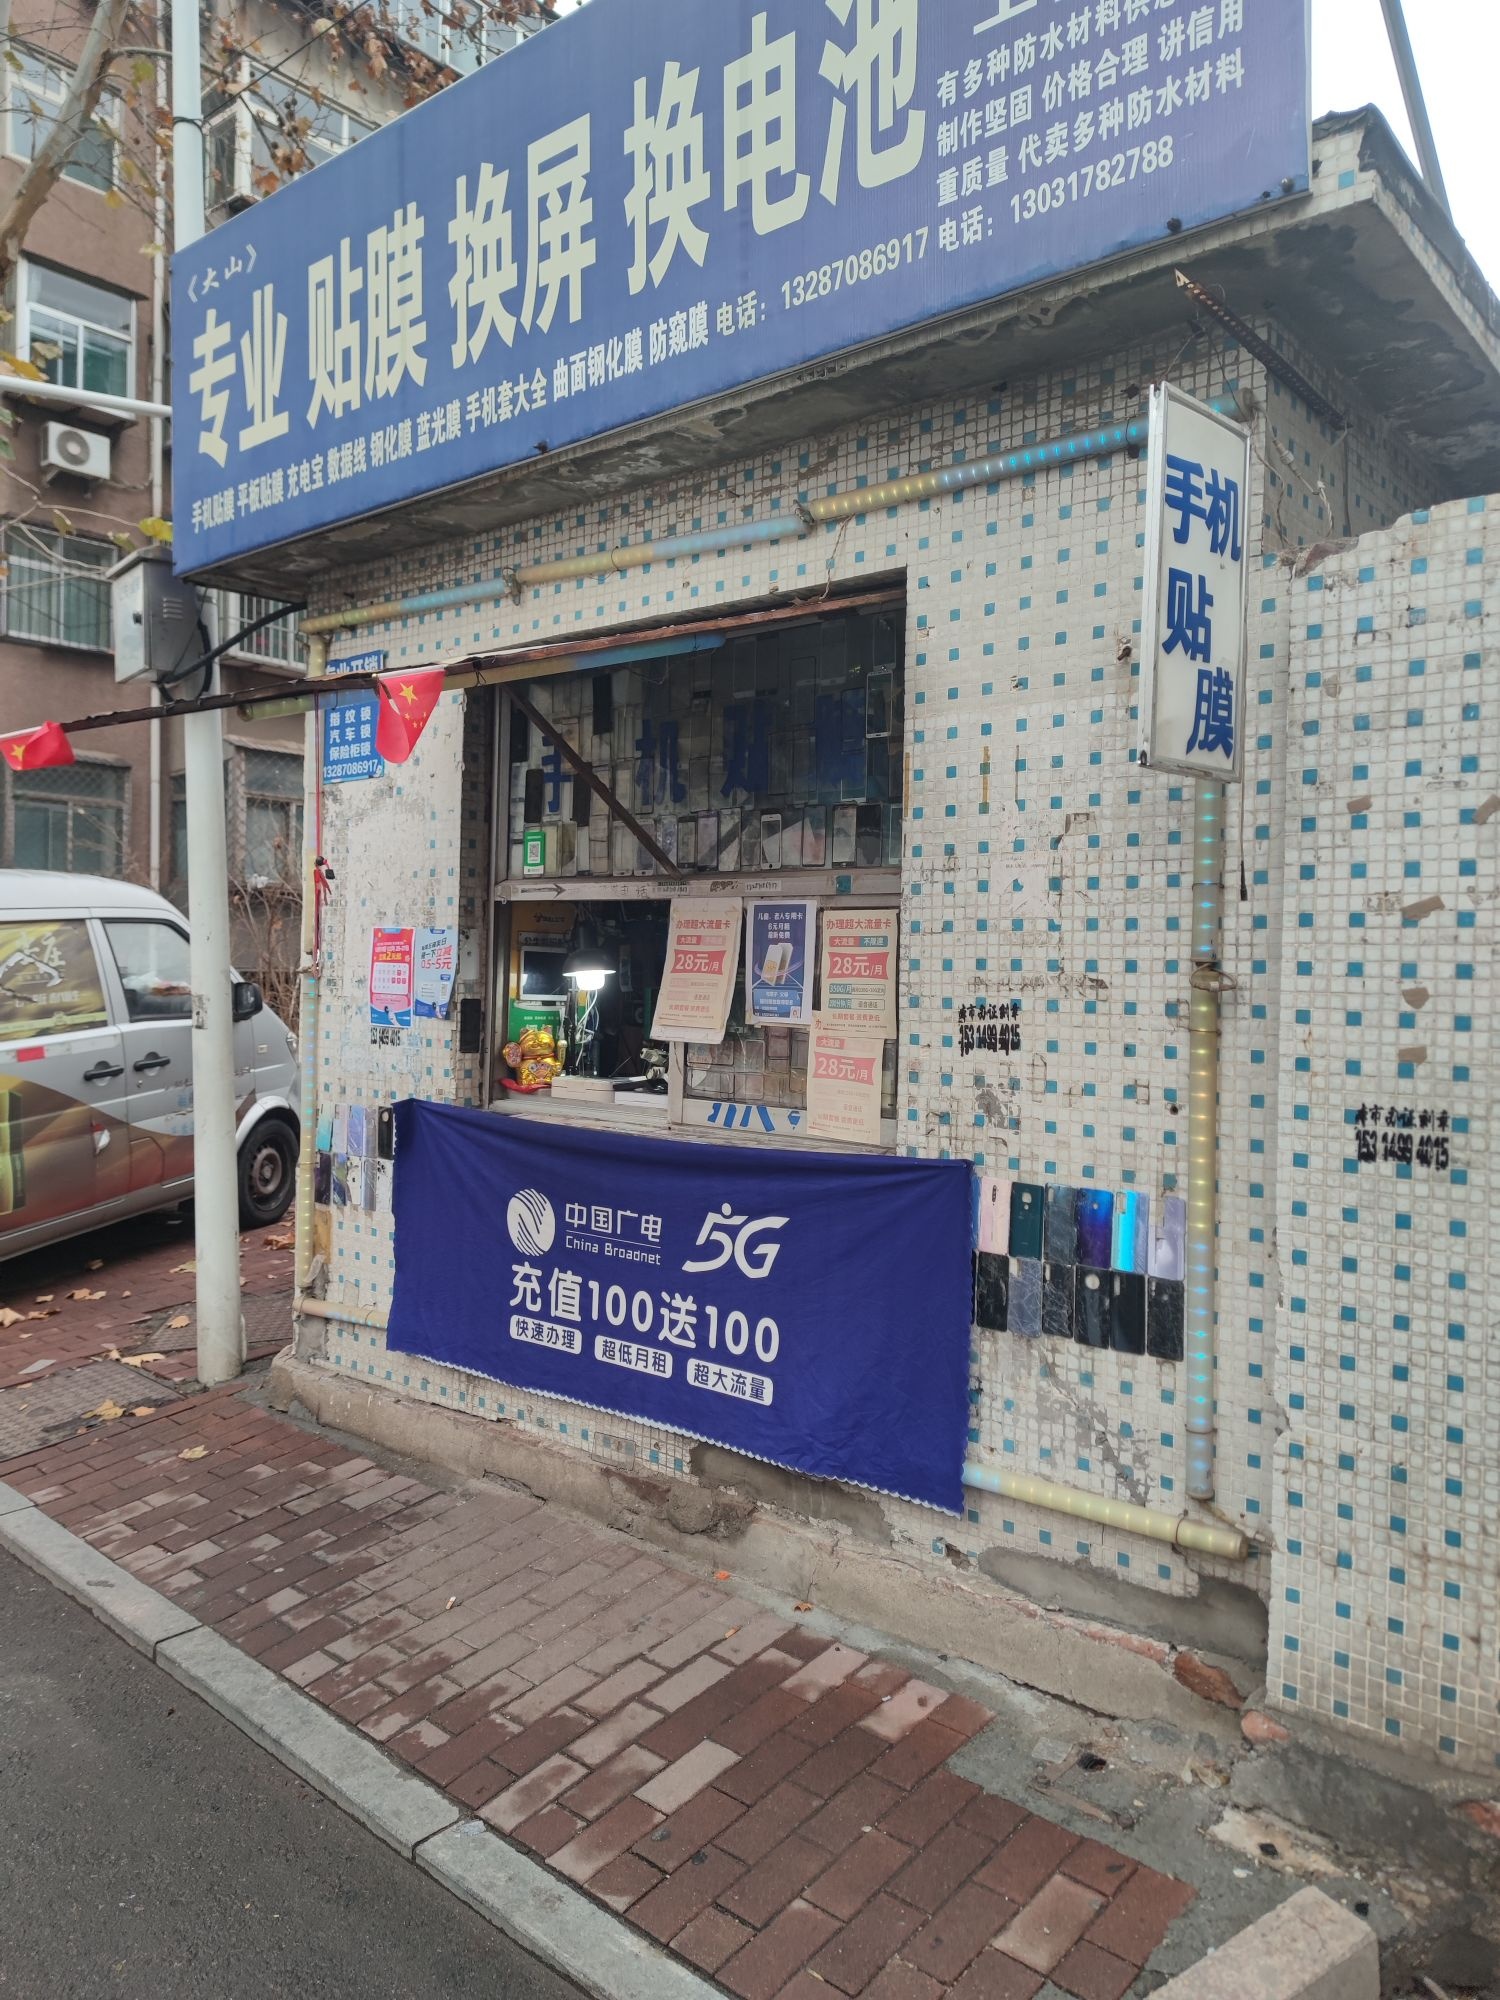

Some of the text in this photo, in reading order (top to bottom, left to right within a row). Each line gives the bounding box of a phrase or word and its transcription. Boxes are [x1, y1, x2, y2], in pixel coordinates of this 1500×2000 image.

[937, 0, 1176, 109] 有多种防水材料供
[936, 0, 1244, 158] 制作坚固 价格合理 讲信用
[936, 47, 1245, 207] 重质量 代卖多种防水材料
[1010, 135, 1174, 223] 13031782788
[189, 0, 926, 468] 专业 贴膜 换屏 换电池
[192, 487, 235, 534] 手机贴膜
[237, 467, 284, 517] 平板贴膜
[287, 453, 324, 499] 充电宝
[327, 436, 367, 485] 数据线
[370, 418, 412, 467] 钢化膜
[416, 399, 461, 452] 蓝光膜
[465, 366, 548, 433] 手机套大全
[553, 326, 643, 402] 曲面钢化膜
[649, 300, 709, 366] 防窥膜
[781, 226, 929, 309] 13287086917
[1162, 452, 1241, 759] 手机贴膜
[329, 706, 372, 727] 指纹锁
[329, 724, 372, 744] 汽车锁
[323, 759, 378, 778] 13287086917
[329, 741, 372, 761] 保险柜锁
[675, 919, 731, 930] 办理超大流量卡
[826, 918, 892, 930] 办理超大流量卡
[833, 937, 884, 946] 大流量 不限速
[675, 953, 721, 972] 28元/月
[832, 956, 883, 976] 28元/月
[817, 1057, 868, 1081] 28元/月
[565, 1202, 663, 1243] 中国广电
[565, 1235, 661, 1265] China Broadnet
[681, 1203, 791, 1279] 5G
[509, 1261, 780, 1363] 充值100送100
[515, 1317, 767, 1402] 快速办理 超低月租 超大流量
